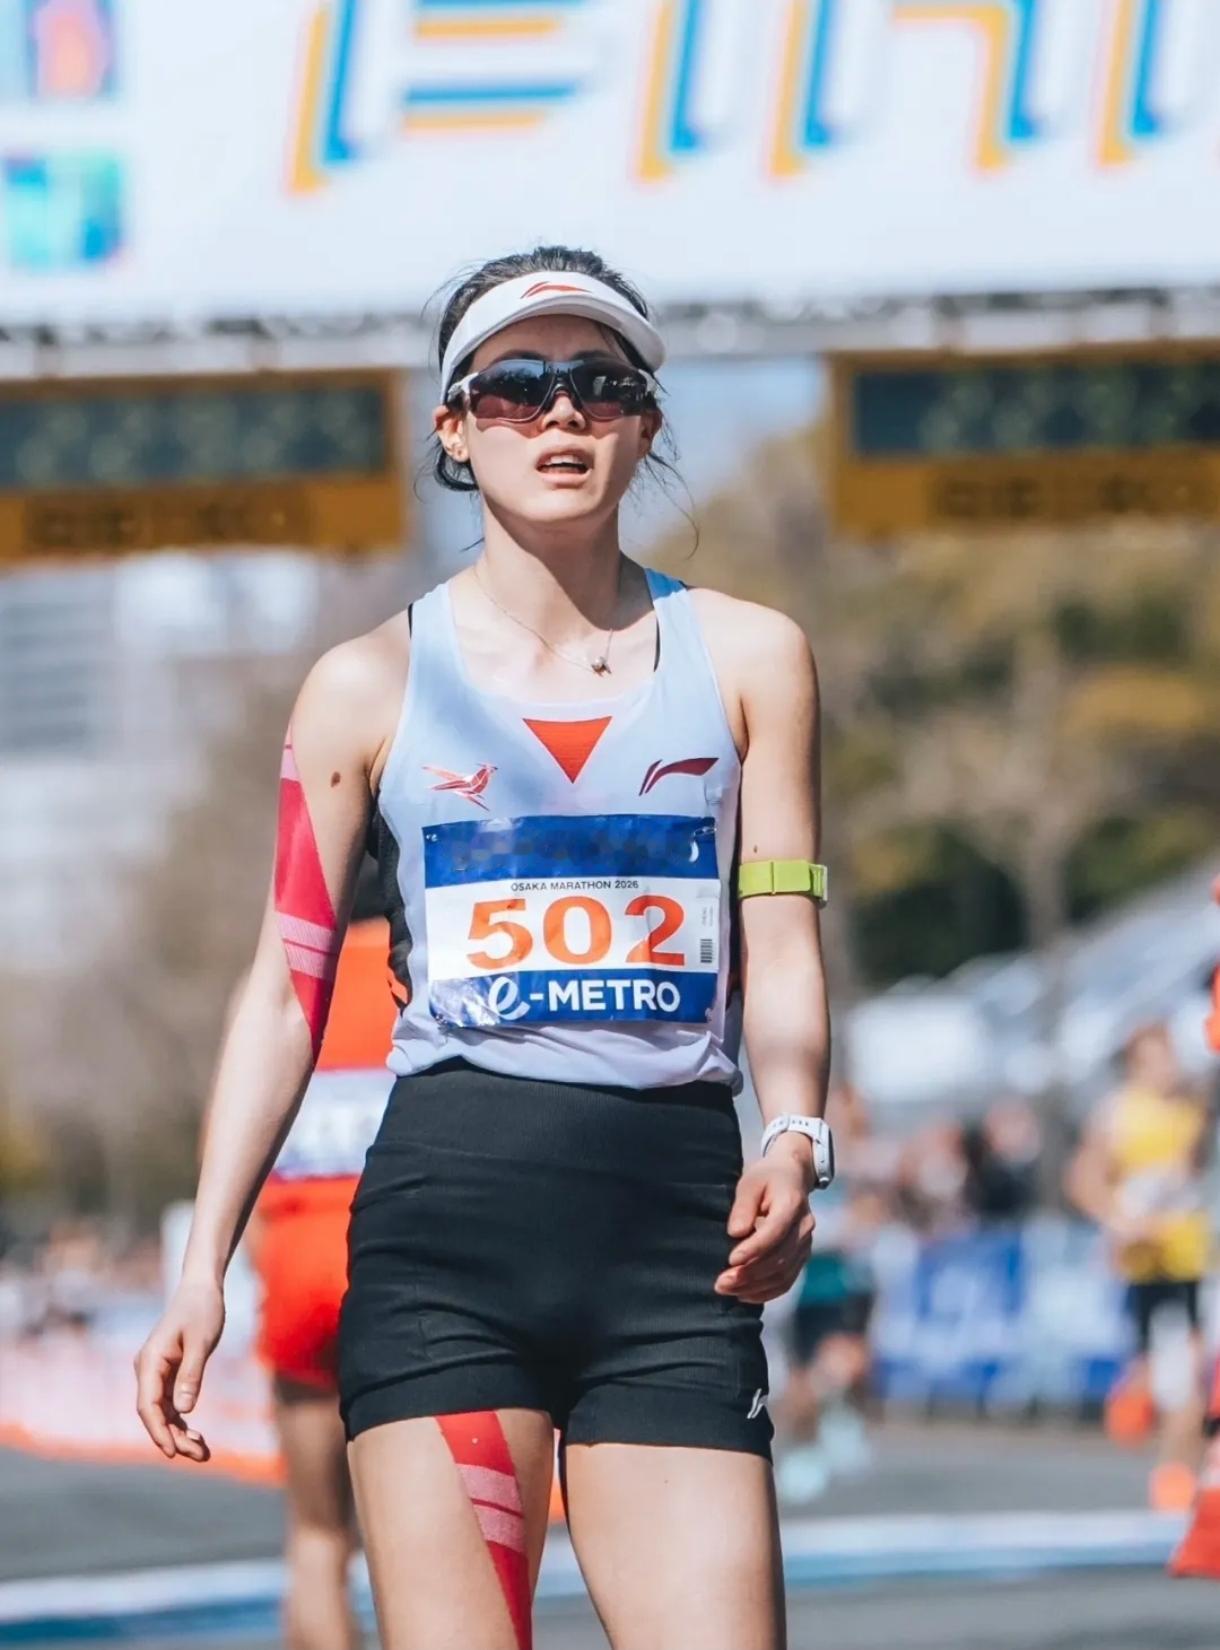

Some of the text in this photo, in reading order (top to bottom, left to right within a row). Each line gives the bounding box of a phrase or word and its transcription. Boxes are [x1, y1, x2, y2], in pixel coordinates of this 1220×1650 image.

[511, 880, 639, 892] OSAKA MARATHON 2026
[466, 895, 685, 970] 502
